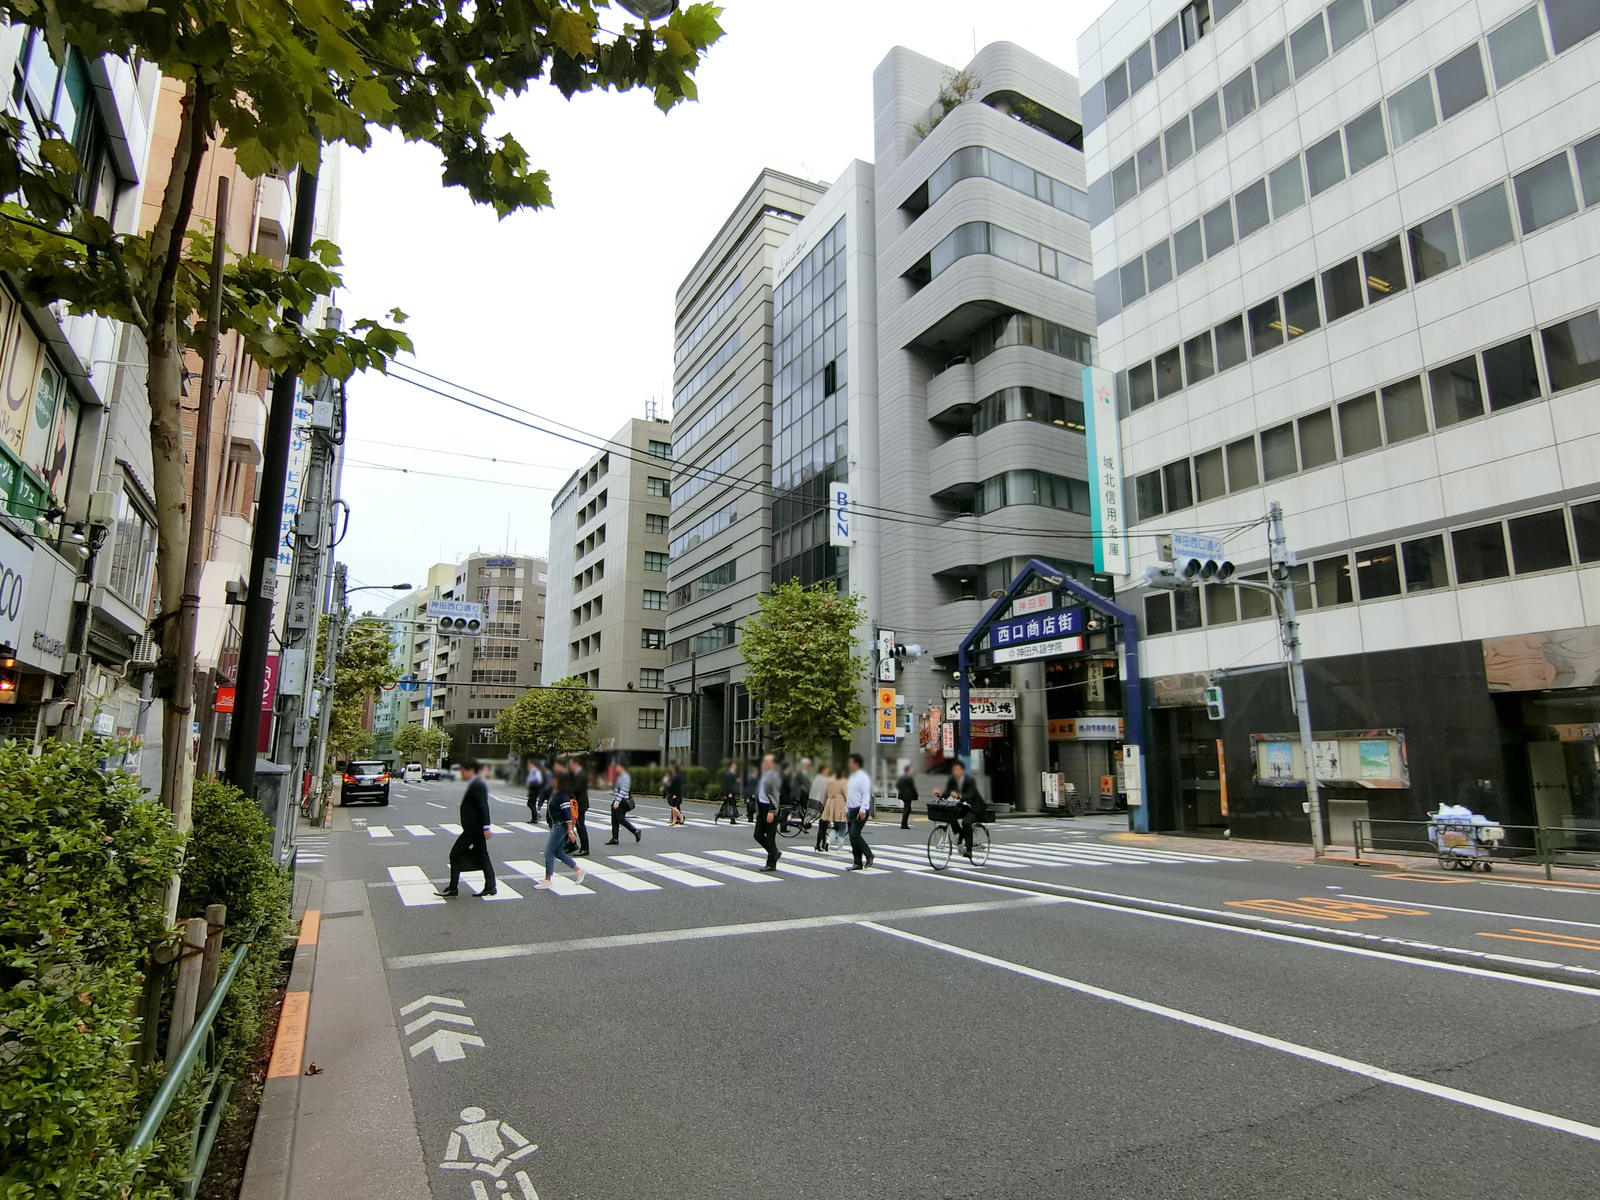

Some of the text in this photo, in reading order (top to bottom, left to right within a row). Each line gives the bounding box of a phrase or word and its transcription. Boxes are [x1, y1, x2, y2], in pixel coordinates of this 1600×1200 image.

[837, 491, 849, 538] BCN
[1103, 456, 1119, 557] 城北信用金庫
[1174, 534, 1221, 553] 神田西口通り
[294, 602, 305, 622] 交通
[431, 601, 479, 612] 神田西口通り
[1019, 595, 1047, 610] 神田駅
[997, 612, 1072, 643] 西口商店街
[1016, 641, 1063, 658] 神田外語学院
[950, 701, 1013, 714] やとり道場
[883, 707, 892, 729] 松屋
